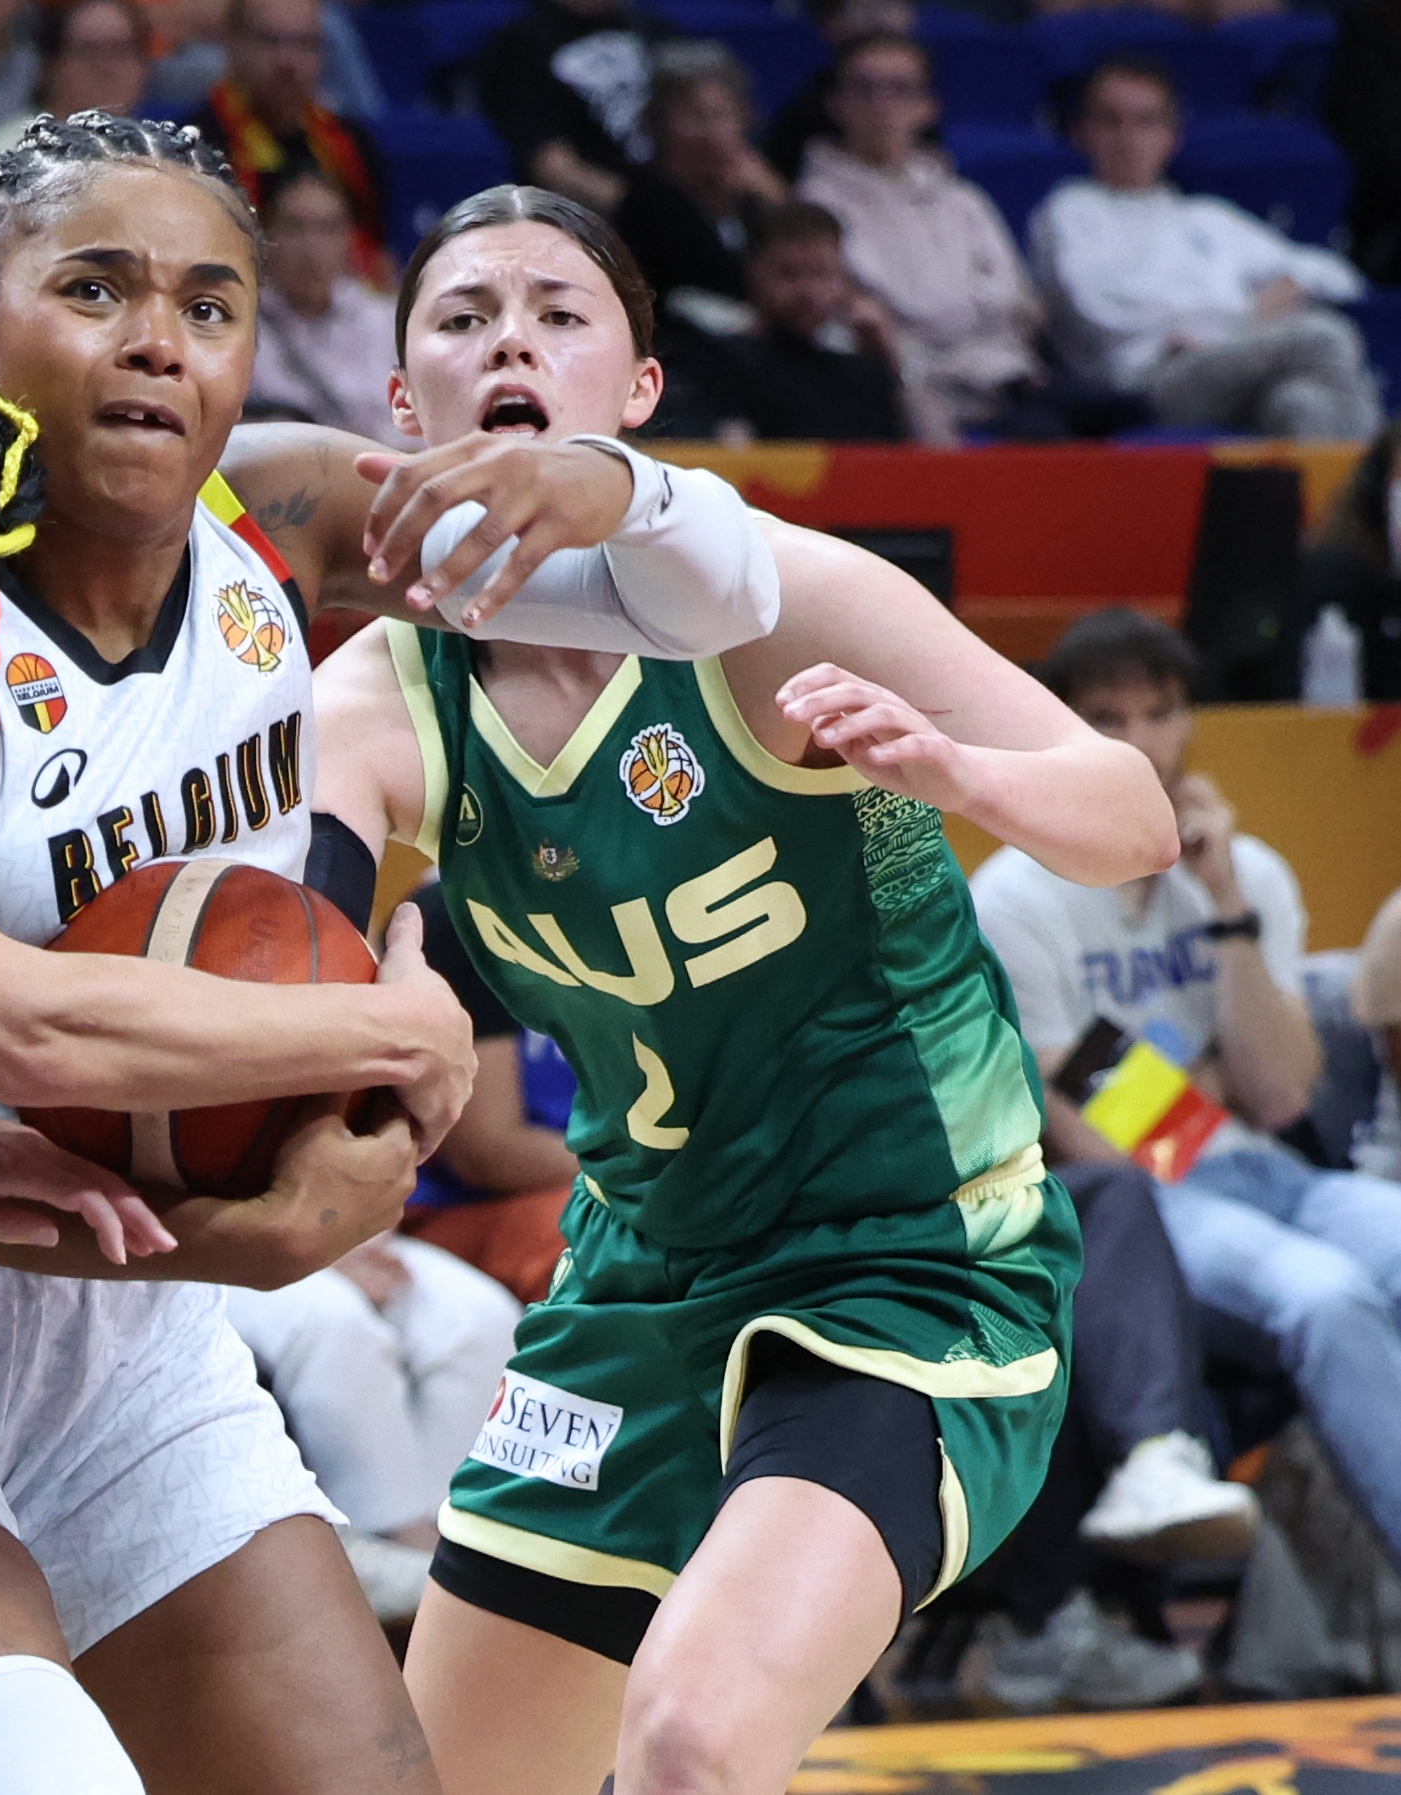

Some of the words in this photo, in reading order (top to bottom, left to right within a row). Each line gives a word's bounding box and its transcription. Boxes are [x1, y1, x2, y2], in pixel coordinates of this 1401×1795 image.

[465, 835, 807, 1006] AUS
[626, 1030, 690, 1150] 2
[472, 1430, 592, 1484] ONSULTING
[501, 1386, 615, 1452] SEVEN
